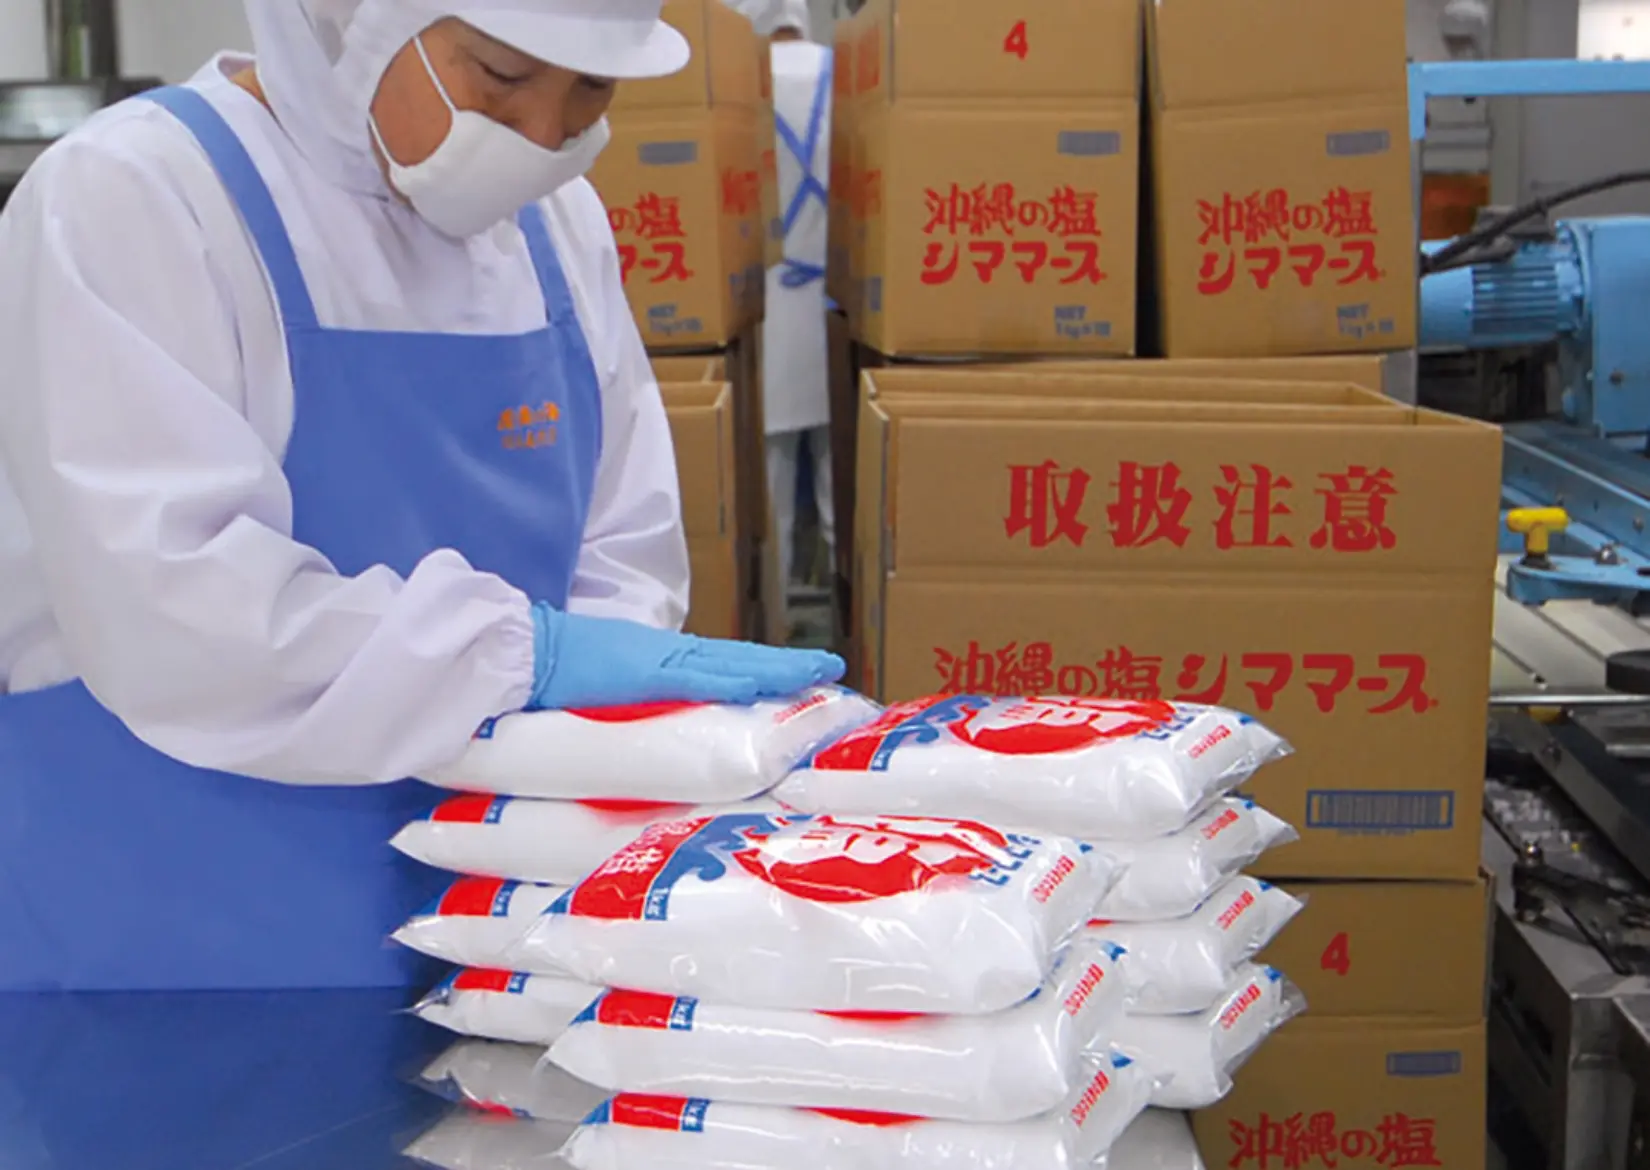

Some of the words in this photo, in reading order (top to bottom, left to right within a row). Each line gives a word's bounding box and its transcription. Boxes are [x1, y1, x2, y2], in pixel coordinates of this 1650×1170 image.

[1002, 19, 1030, 60] 4
[922, 181, 1102, 237] 沖縄の塩
[1196, 186, 1379, 247] 沖縄の塩
[920, 240, 1103, 286] シママース
[1195, 239, 1382, 296] シママース
[1003, 458, 1399, 554] 取扱注意
[1172, 652, 1428, 716] シママース
[1320, 932, 1350, 976] 4
[1228, 1110, 1442, 1169] 沖縄の塩
